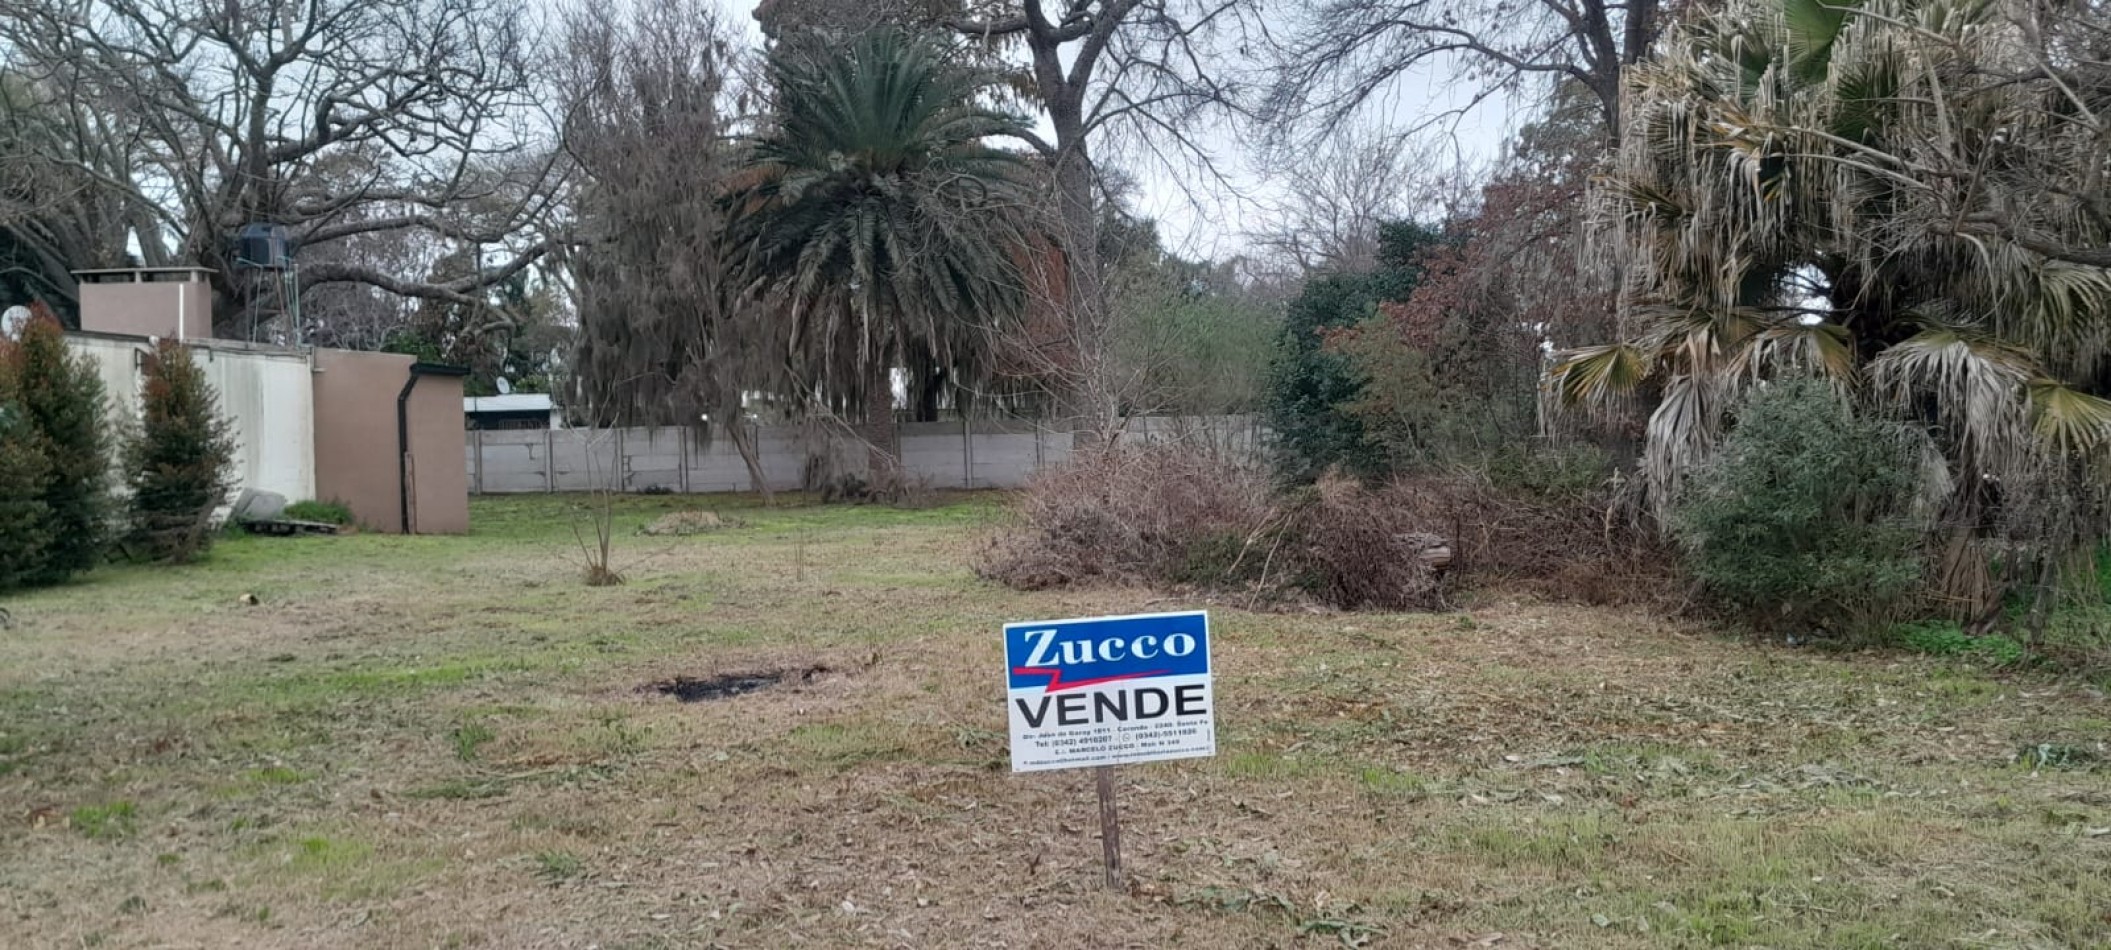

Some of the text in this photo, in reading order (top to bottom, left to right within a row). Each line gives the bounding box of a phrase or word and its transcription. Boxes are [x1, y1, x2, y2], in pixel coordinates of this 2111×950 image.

[1024, 628, 1196, 668] Zucco
[1015, 684, 1207, 729] VENDE
[1108, 743, 1135, 751] ZUCCO
